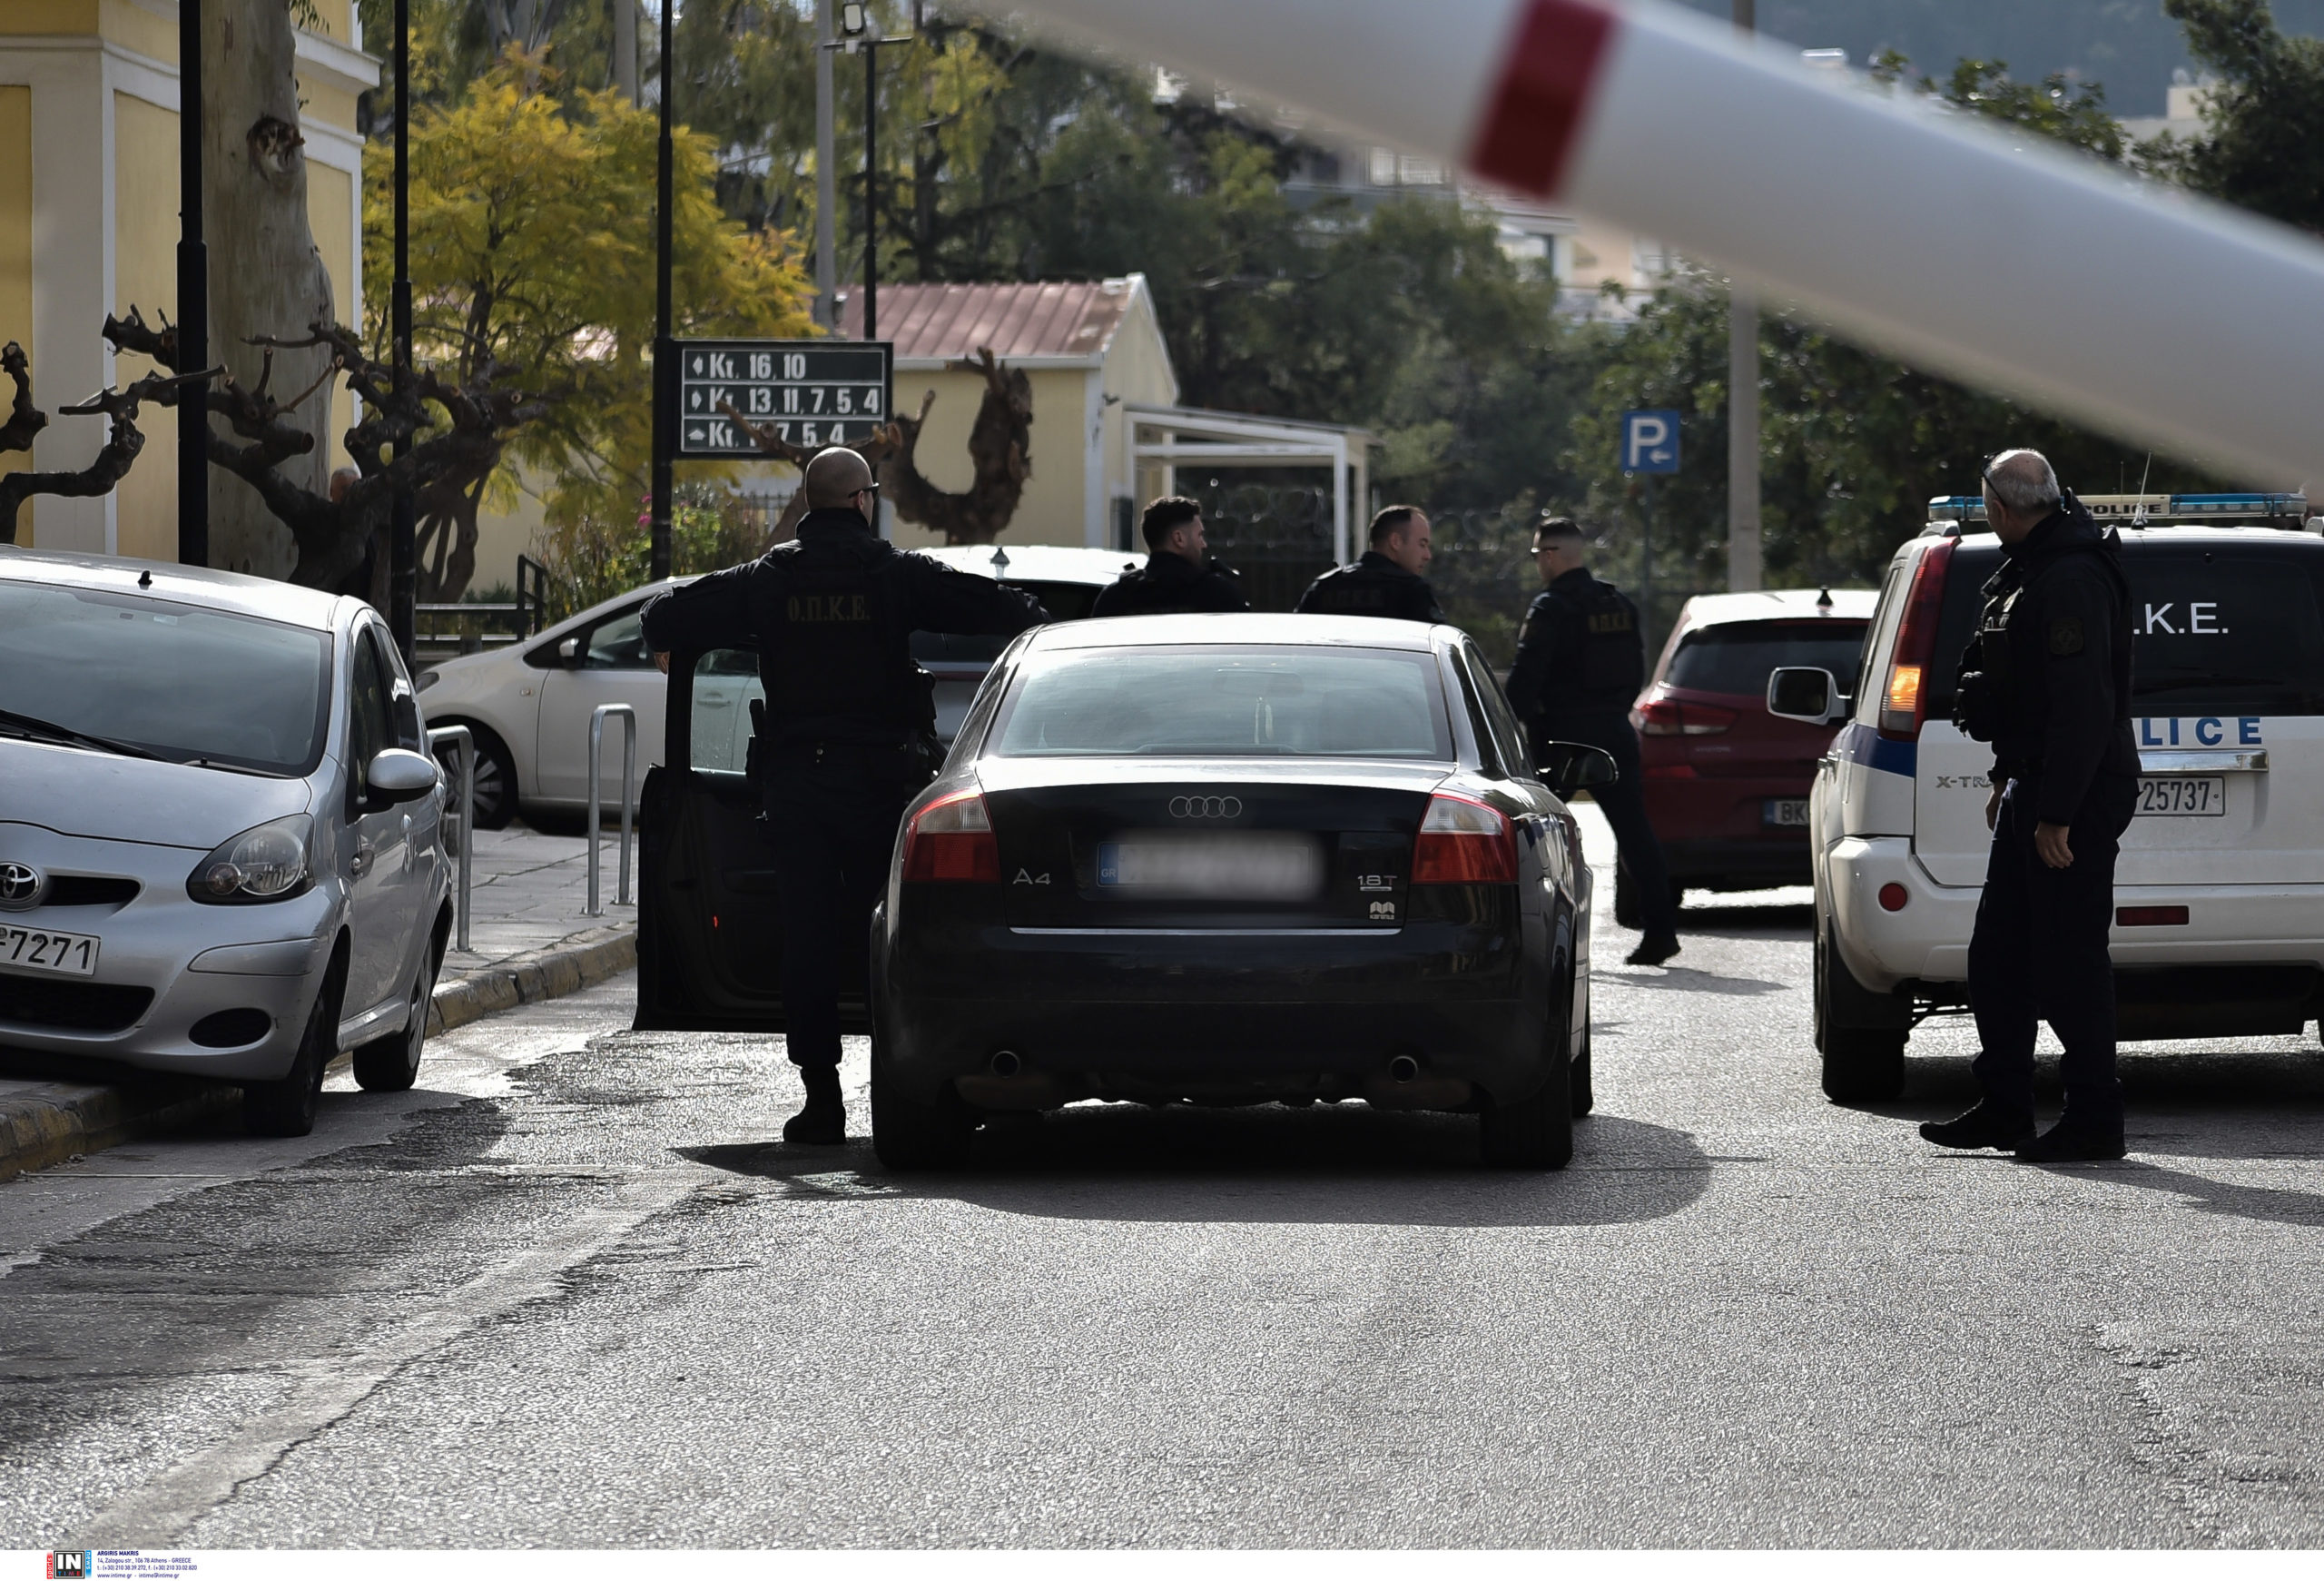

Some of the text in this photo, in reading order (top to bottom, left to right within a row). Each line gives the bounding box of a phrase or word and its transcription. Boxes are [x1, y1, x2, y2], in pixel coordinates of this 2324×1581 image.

[749, 352, 777, 381] 16,
[783, 352, 806, 380] 10
[749, 387, 777, 415] 13,
[783, 387, 804, 415] 11,
[811, 387, 832, 415] 7,
[836, 388, 858, 416] 5,
[863, 388, 879, 413] 4
[829, 422, 844, 445] 4
[1629, 415, 1669, 468] P
[787, 595, 871, 622] Ο.Π.Κ.Ε.
[2142, 781, 2211, 811] 25737
[1012, 867, 1051, 885] A4
[1101, 868, 1117, 878] GR
